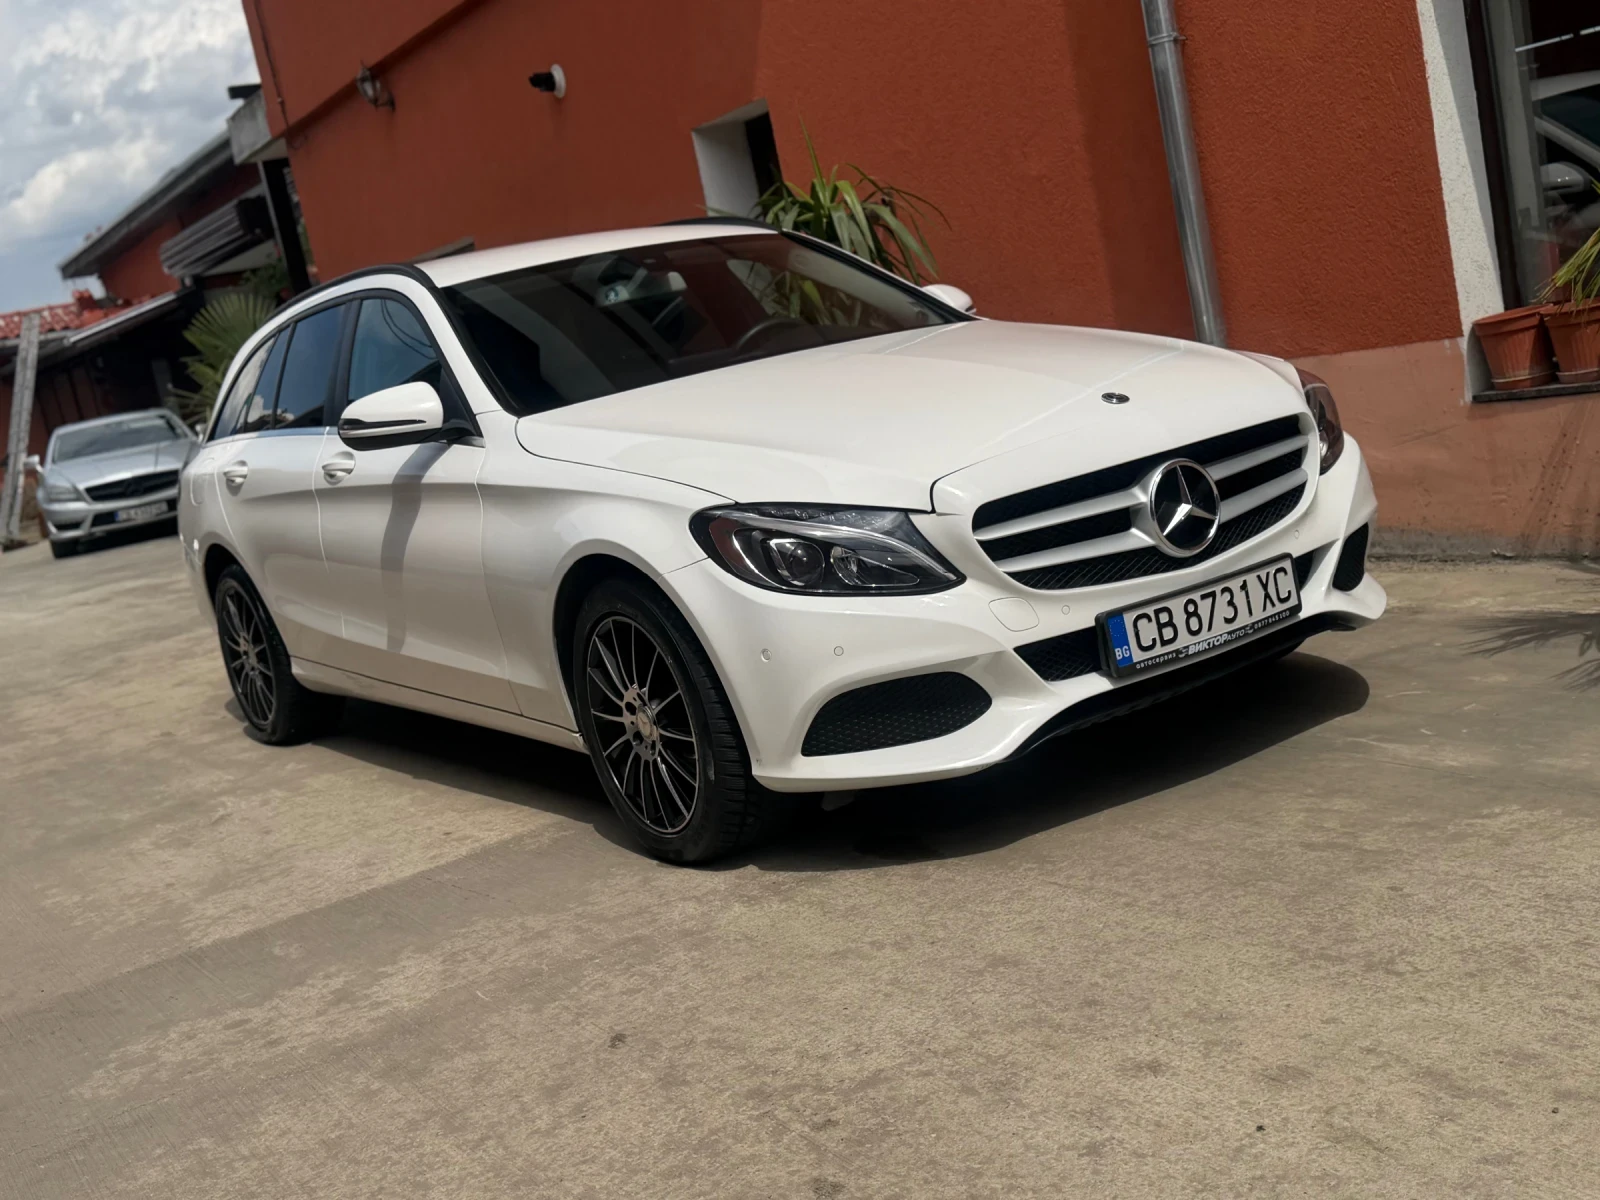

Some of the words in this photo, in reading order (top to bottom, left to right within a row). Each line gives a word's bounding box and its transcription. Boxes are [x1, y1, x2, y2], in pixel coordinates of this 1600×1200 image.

[1132, 606, 1178, 652] CB
[1183, 579, 1253, 637] 8731
[1256, 566, 1292, 613] XC
[1114, 645, 1130, 660] BG
[1135, 653, 1177, 669] автосервиз
